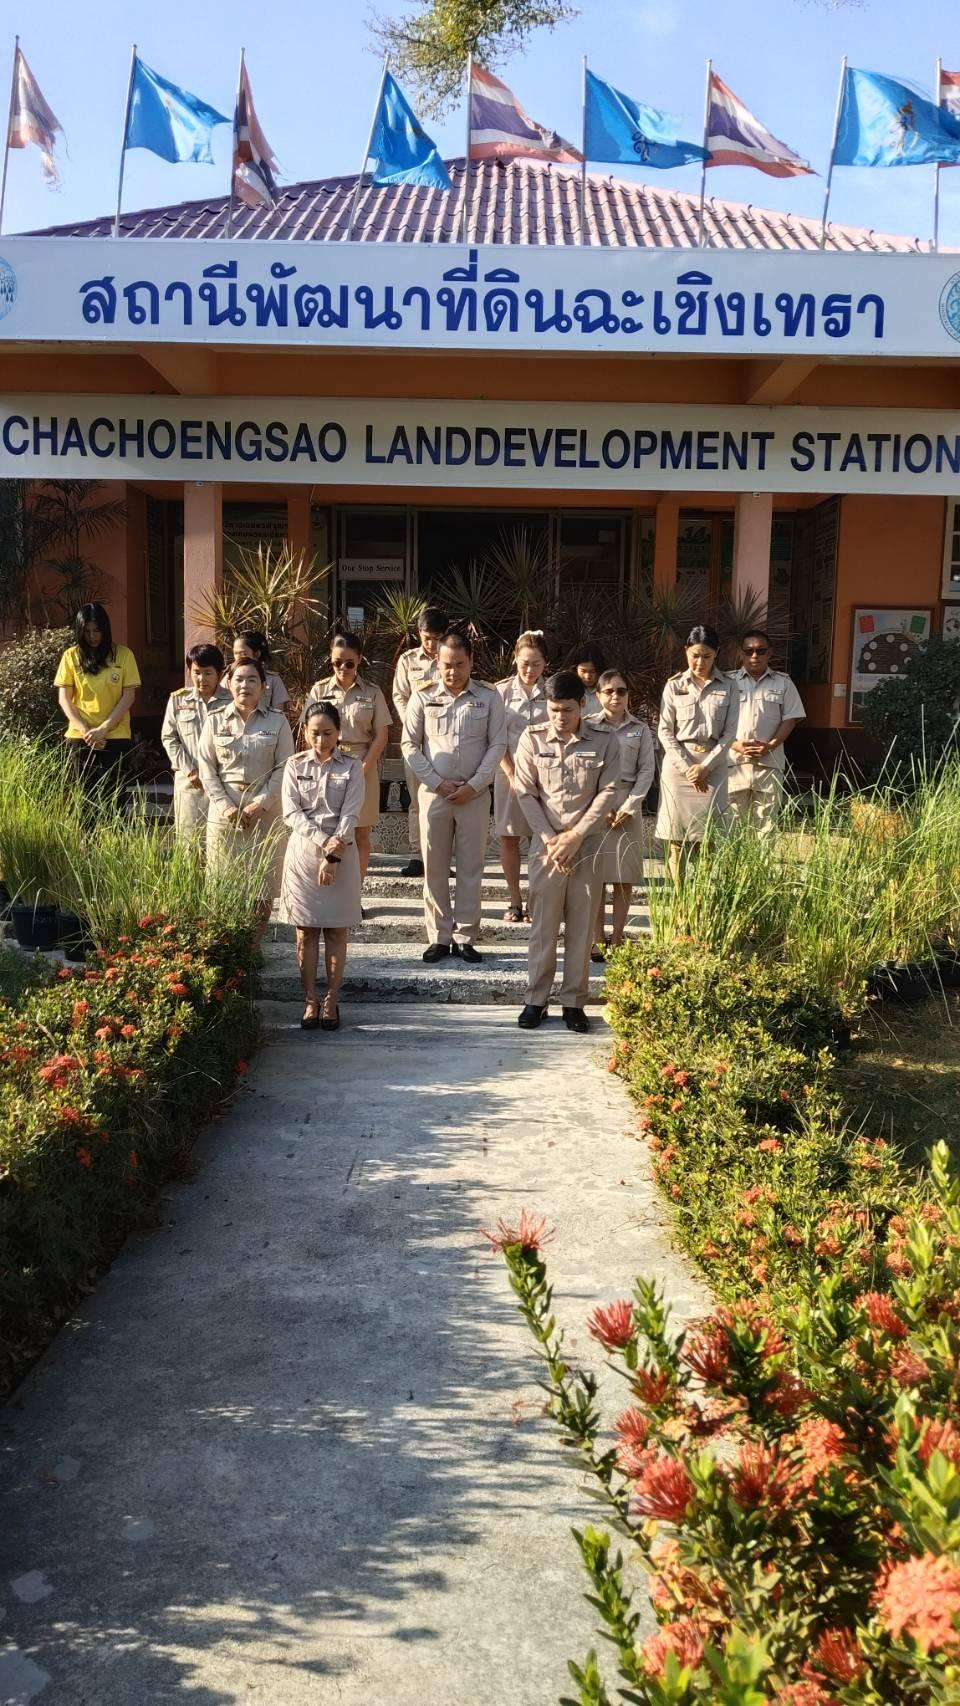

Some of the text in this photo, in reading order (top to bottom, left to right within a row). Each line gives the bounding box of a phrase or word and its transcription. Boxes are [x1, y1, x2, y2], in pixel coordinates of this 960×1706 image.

[79, 249, 885, 338] สถานีพัฒนาที่ดินฉะเชิงเทรา
[2, 415, 960, 473] CHACHOENGSAO LANDDEVELOPMENT STATION
[358, 563, 374, 574] Stop
[376, 563, 401, 572] Service
